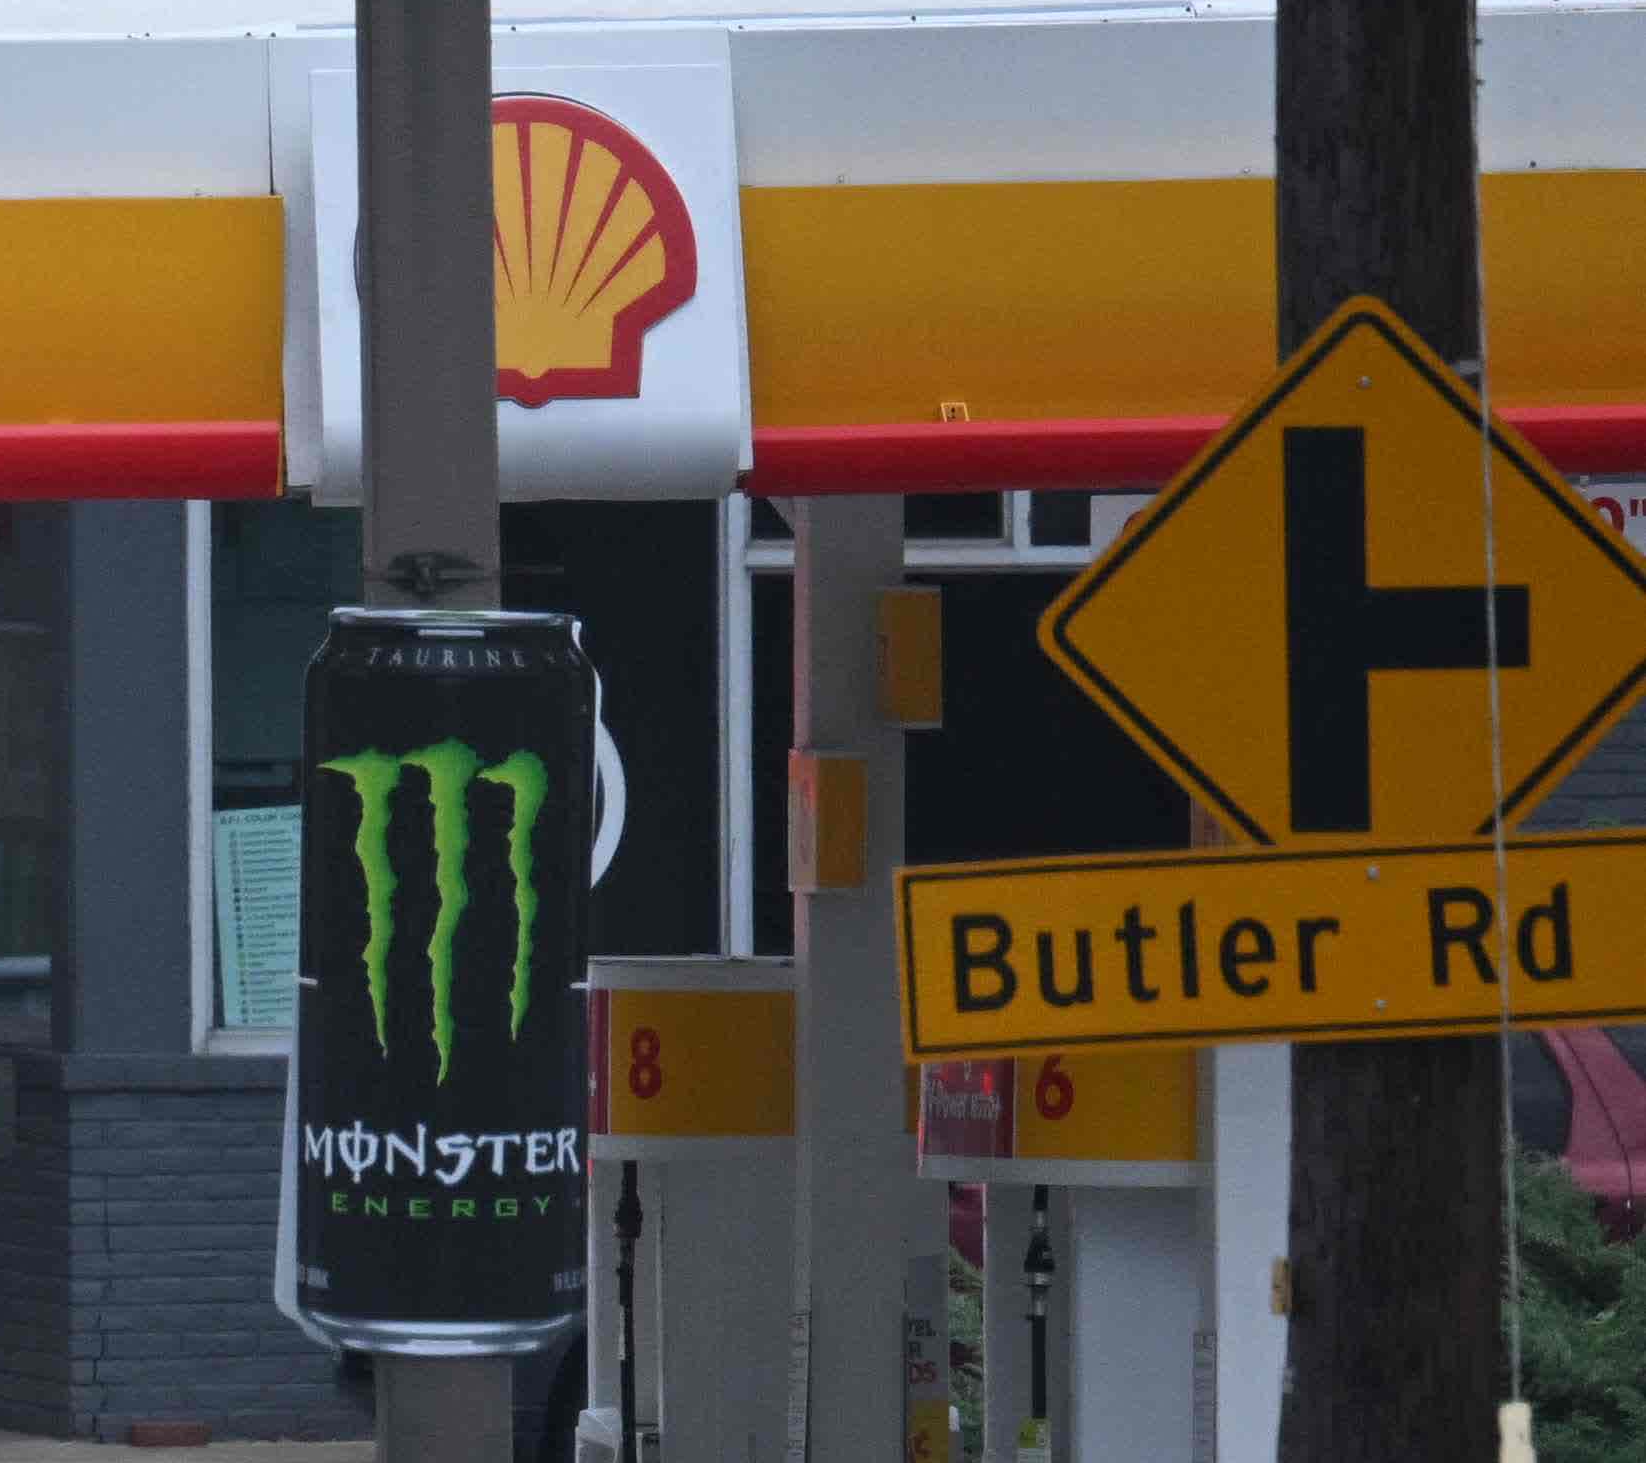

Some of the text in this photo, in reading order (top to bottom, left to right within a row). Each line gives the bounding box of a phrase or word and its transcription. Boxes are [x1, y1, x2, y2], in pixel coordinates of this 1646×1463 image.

[368, 647, 526, 668] TAURINE
[950, 881, 1575, 1014] Butler Rd
[629, 1026, 662, 1099] 8
[1035, 1054, 1074, 1120] 6
[304, 1119, 580, 1185] MONSTER
[331, 1191, 551, 1217] ENERGY
